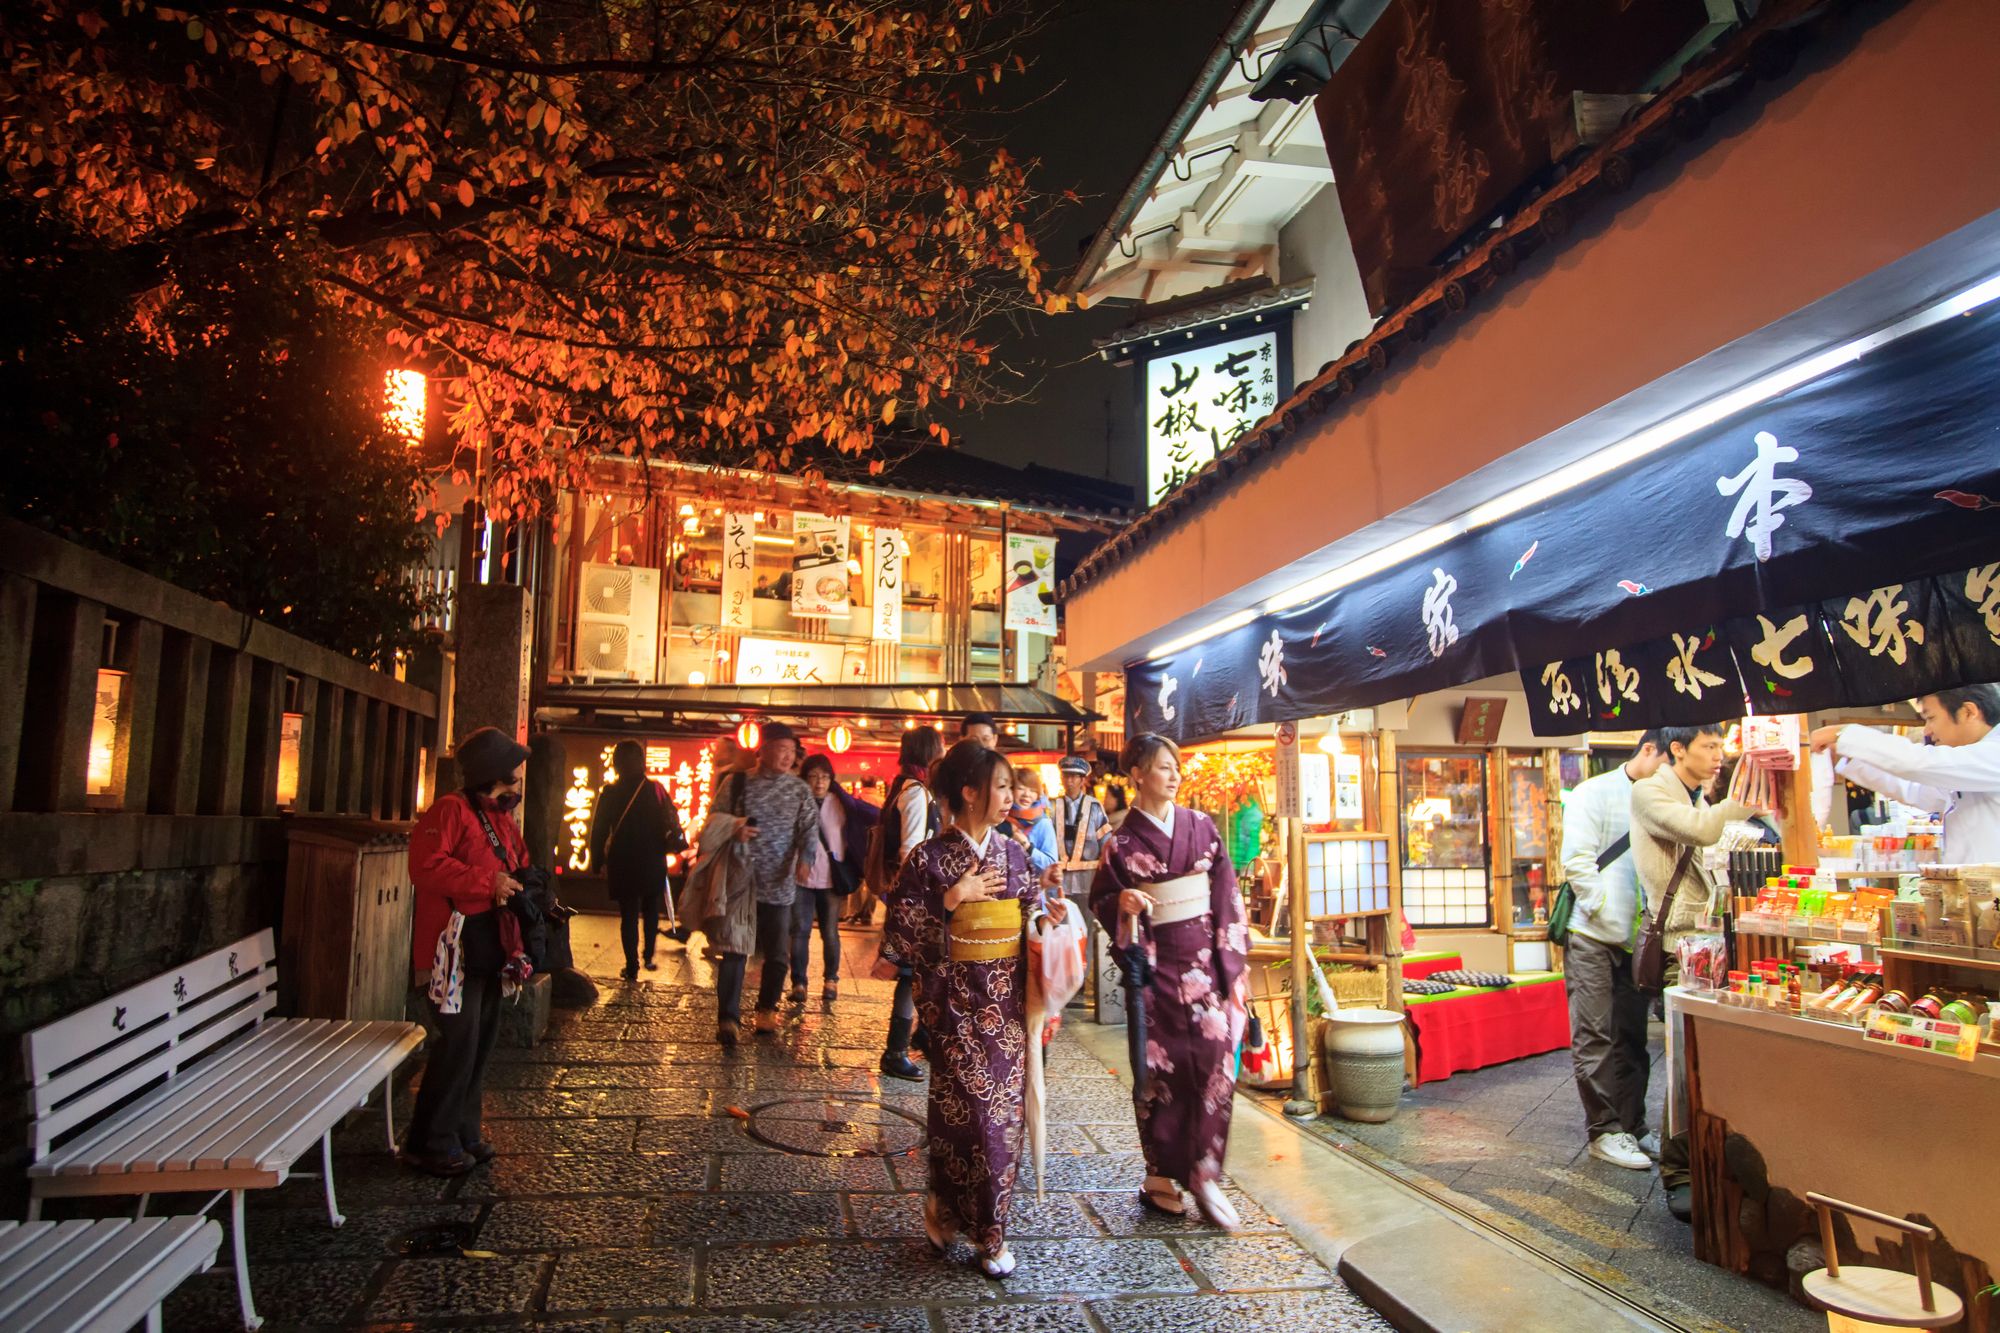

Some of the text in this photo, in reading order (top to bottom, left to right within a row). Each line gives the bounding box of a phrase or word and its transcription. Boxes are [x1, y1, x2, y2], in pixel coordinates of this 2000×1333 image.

[1258, 341, 1276, 408] 京名物
[728, 524, 751, 570] そば
[878, 536, 898, 589] うどん
[488, 831, 500, 847] EOS
[111, 951, 240, 1032] 七味家
